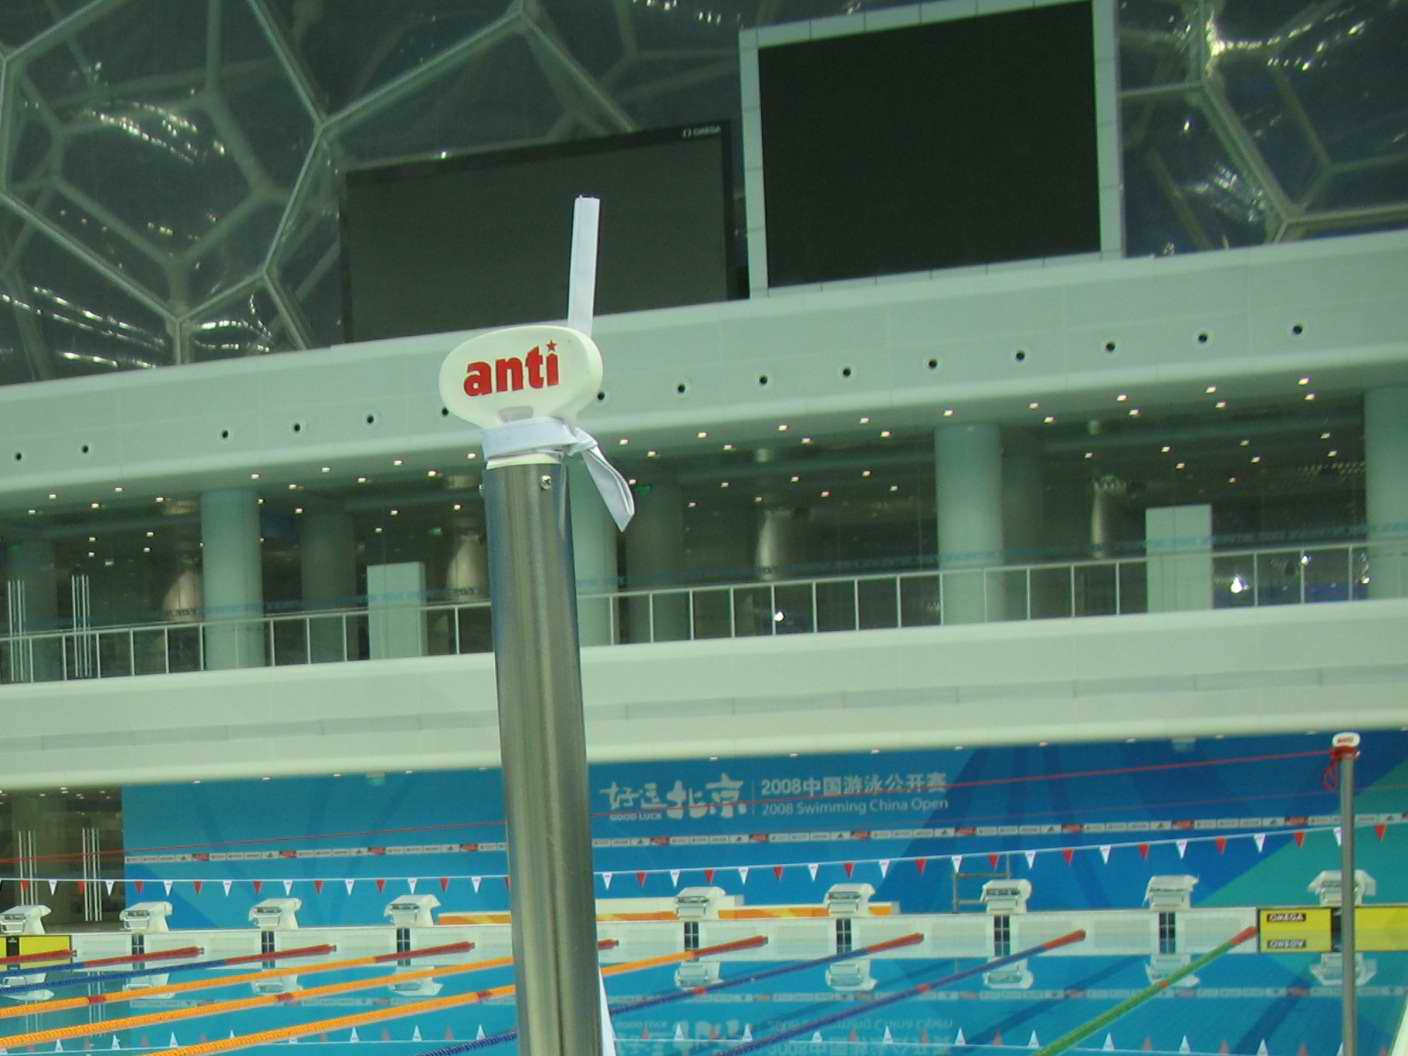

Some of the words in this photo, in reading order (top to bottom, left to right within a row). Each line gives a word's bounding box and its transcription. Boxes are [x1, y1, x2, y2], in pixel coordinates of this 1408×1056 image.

[463, 340, 559, 397] anti
[763, 801, 793, 816] 2008
[796, 801, 867, 815] Swimming
[870, 799, 908, 812] China
[911, 798, 949, 813] Open
